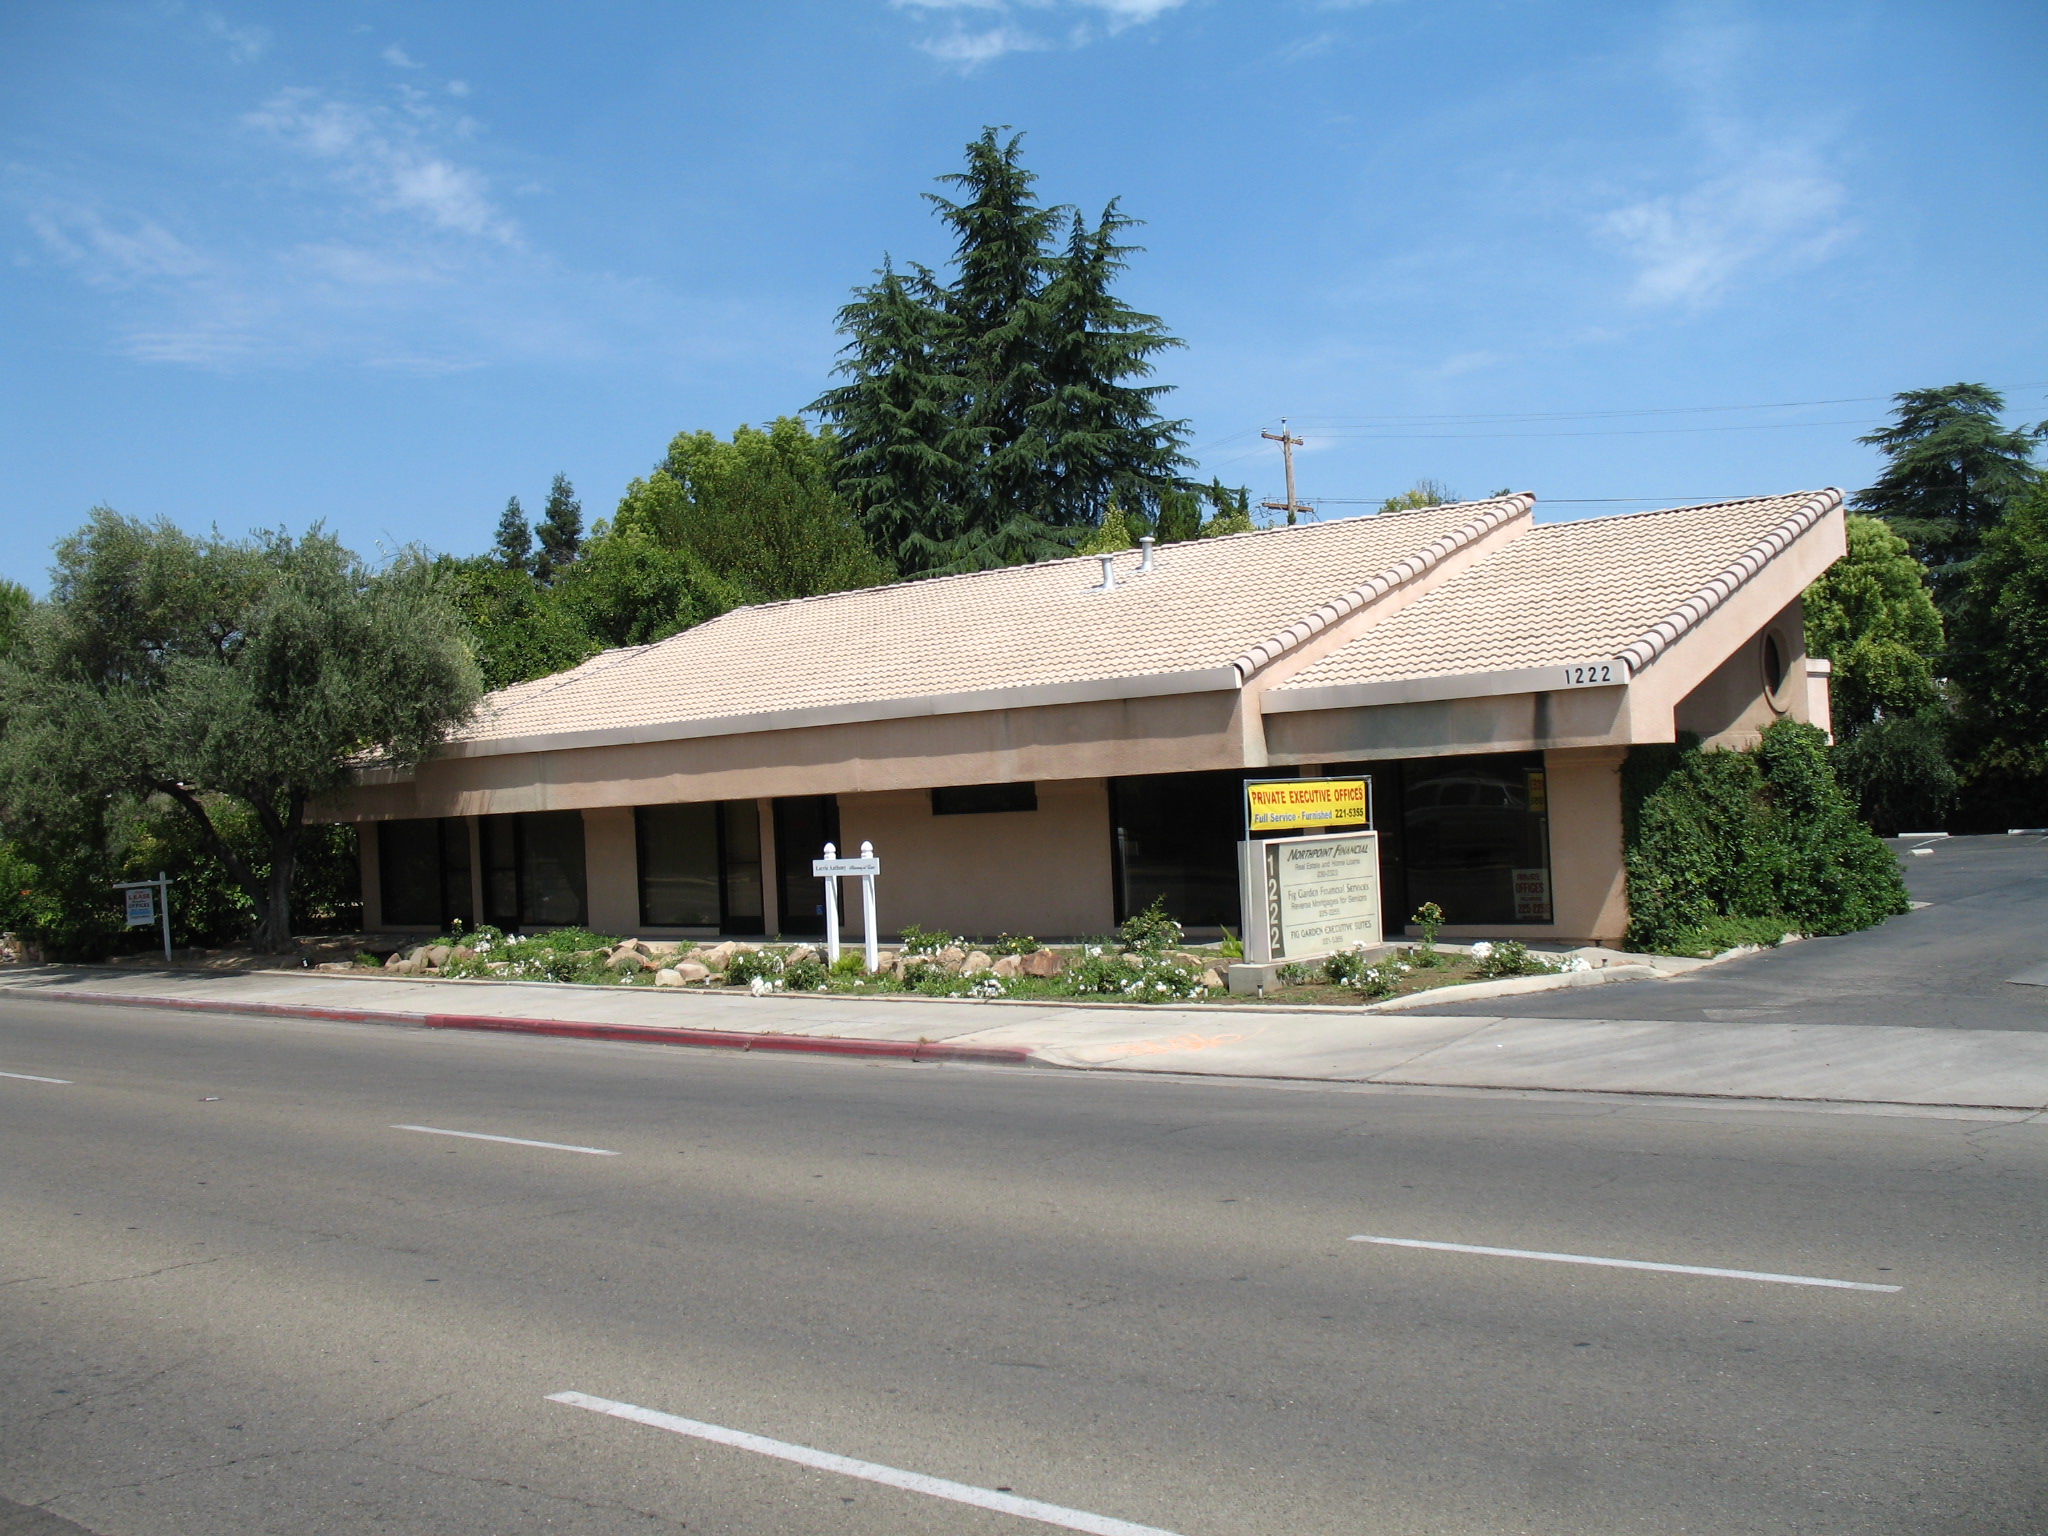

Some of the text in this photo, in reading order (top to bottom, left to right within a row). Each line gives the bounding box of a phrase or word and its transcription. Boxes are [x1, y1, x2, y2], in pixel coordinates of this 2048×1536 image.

[1565, 666, 1610, 684] 1222
[1251, 787, 1363, 804] PRIVATE EXECUTIVE OFFICES
[1254, 813, 1268, 823] Full
[1270, 812, 1296, 822] Service
[1301, 810, 1332, 820] Furnished
[1335, 808, 1364, 818] 221-5355
[1287, 844, 1368, 862] NORTHPOINT FINANCIAL
[1295, 863, 1305, 871] Real
[1306, 862, 1320, 870] Estate
[1332, 859, 1345, 867] Home
[1517, 873, 1540, 881] PRIVATE
[1515, 882, 1544, 893] OFFICES
[1267, 855, 1281, 949] 1222
[1287, 890, 1296, 901] Fig
[1291, 901, 1311, 910] Reverse
[1312, 898, 1339, 909] Mortgages
[1339, 896, 1347, 904] for
[1290, 930, 1300, 940] FIG
[1301, 927, 1323, 938] GARDEN
[1324, 923, 1353, 935] EXECUTIVE
